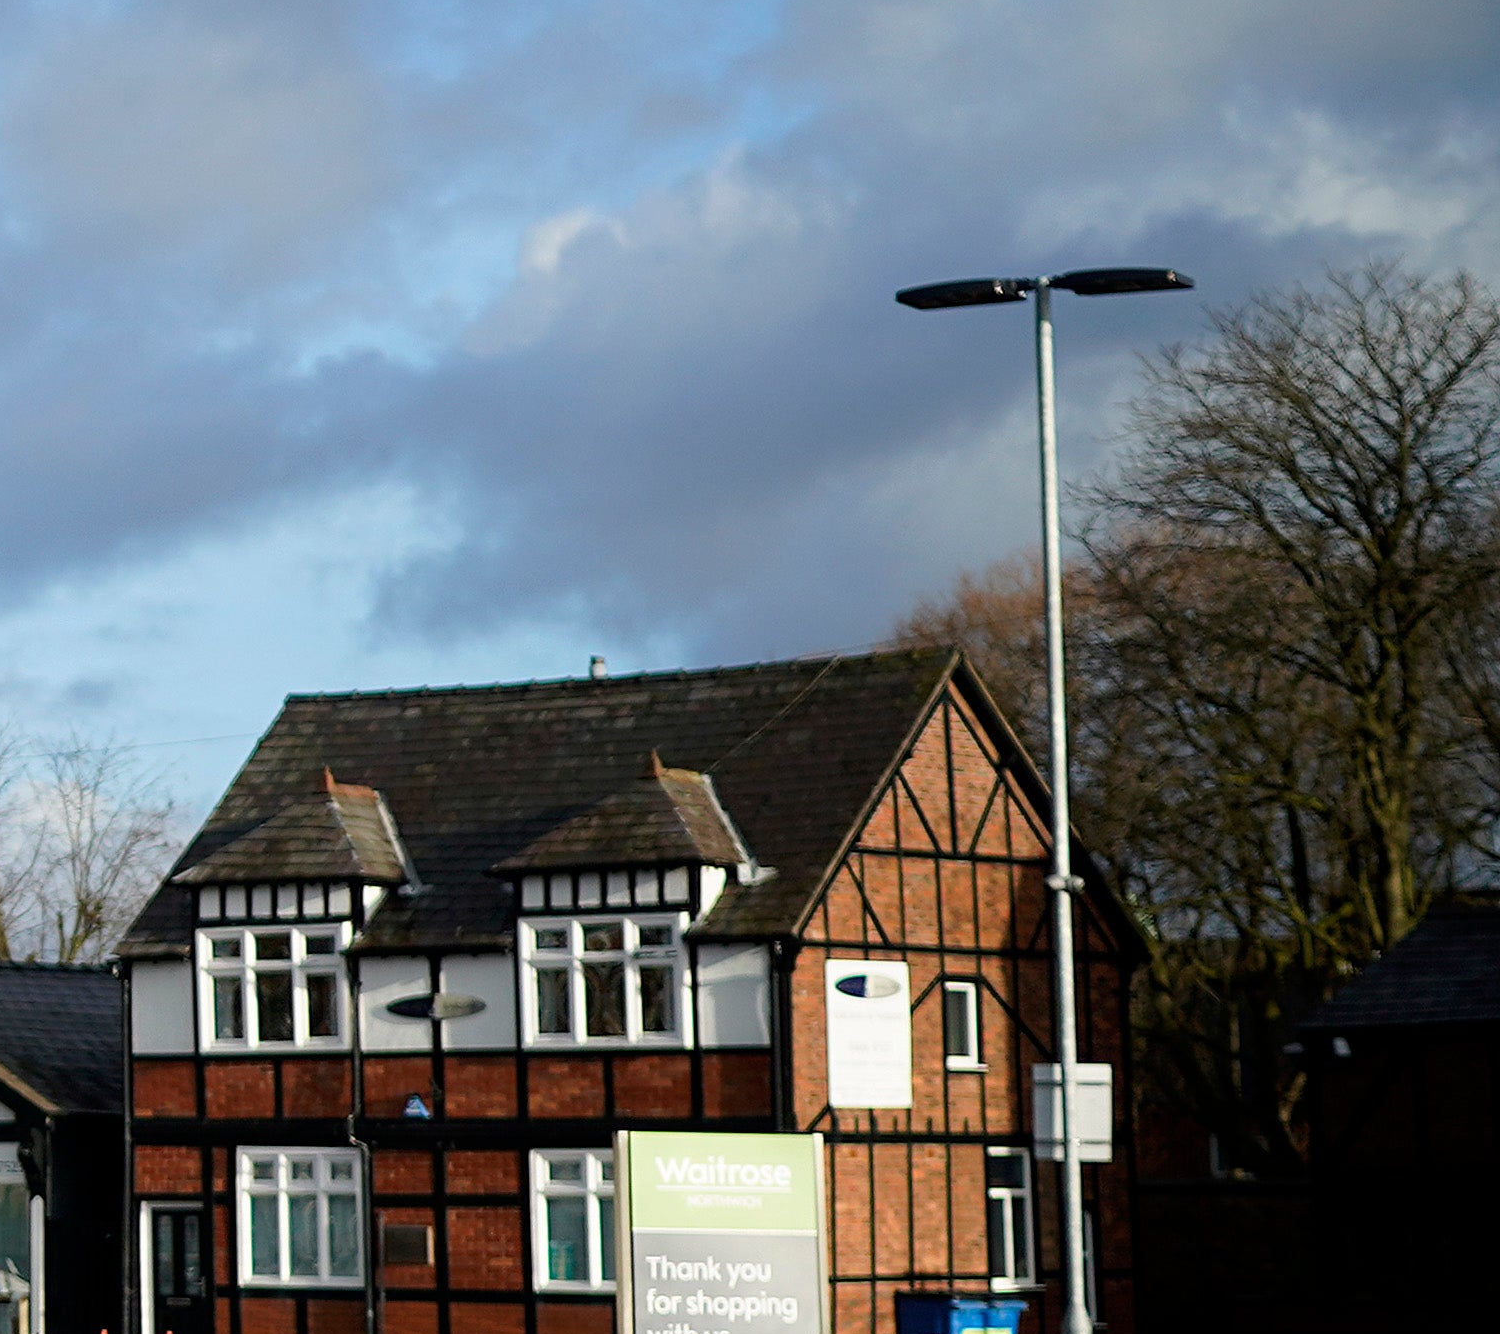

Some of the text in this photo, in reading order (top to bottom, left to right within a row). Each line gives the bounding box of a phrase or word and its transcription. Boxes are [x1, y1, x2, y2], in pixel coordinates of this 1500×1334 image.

[654, 1155, 792, 1186] Waitrose
[645, 1254, 772, 1289] Thank you
[646, 1287, 798, 1325] for shopping
